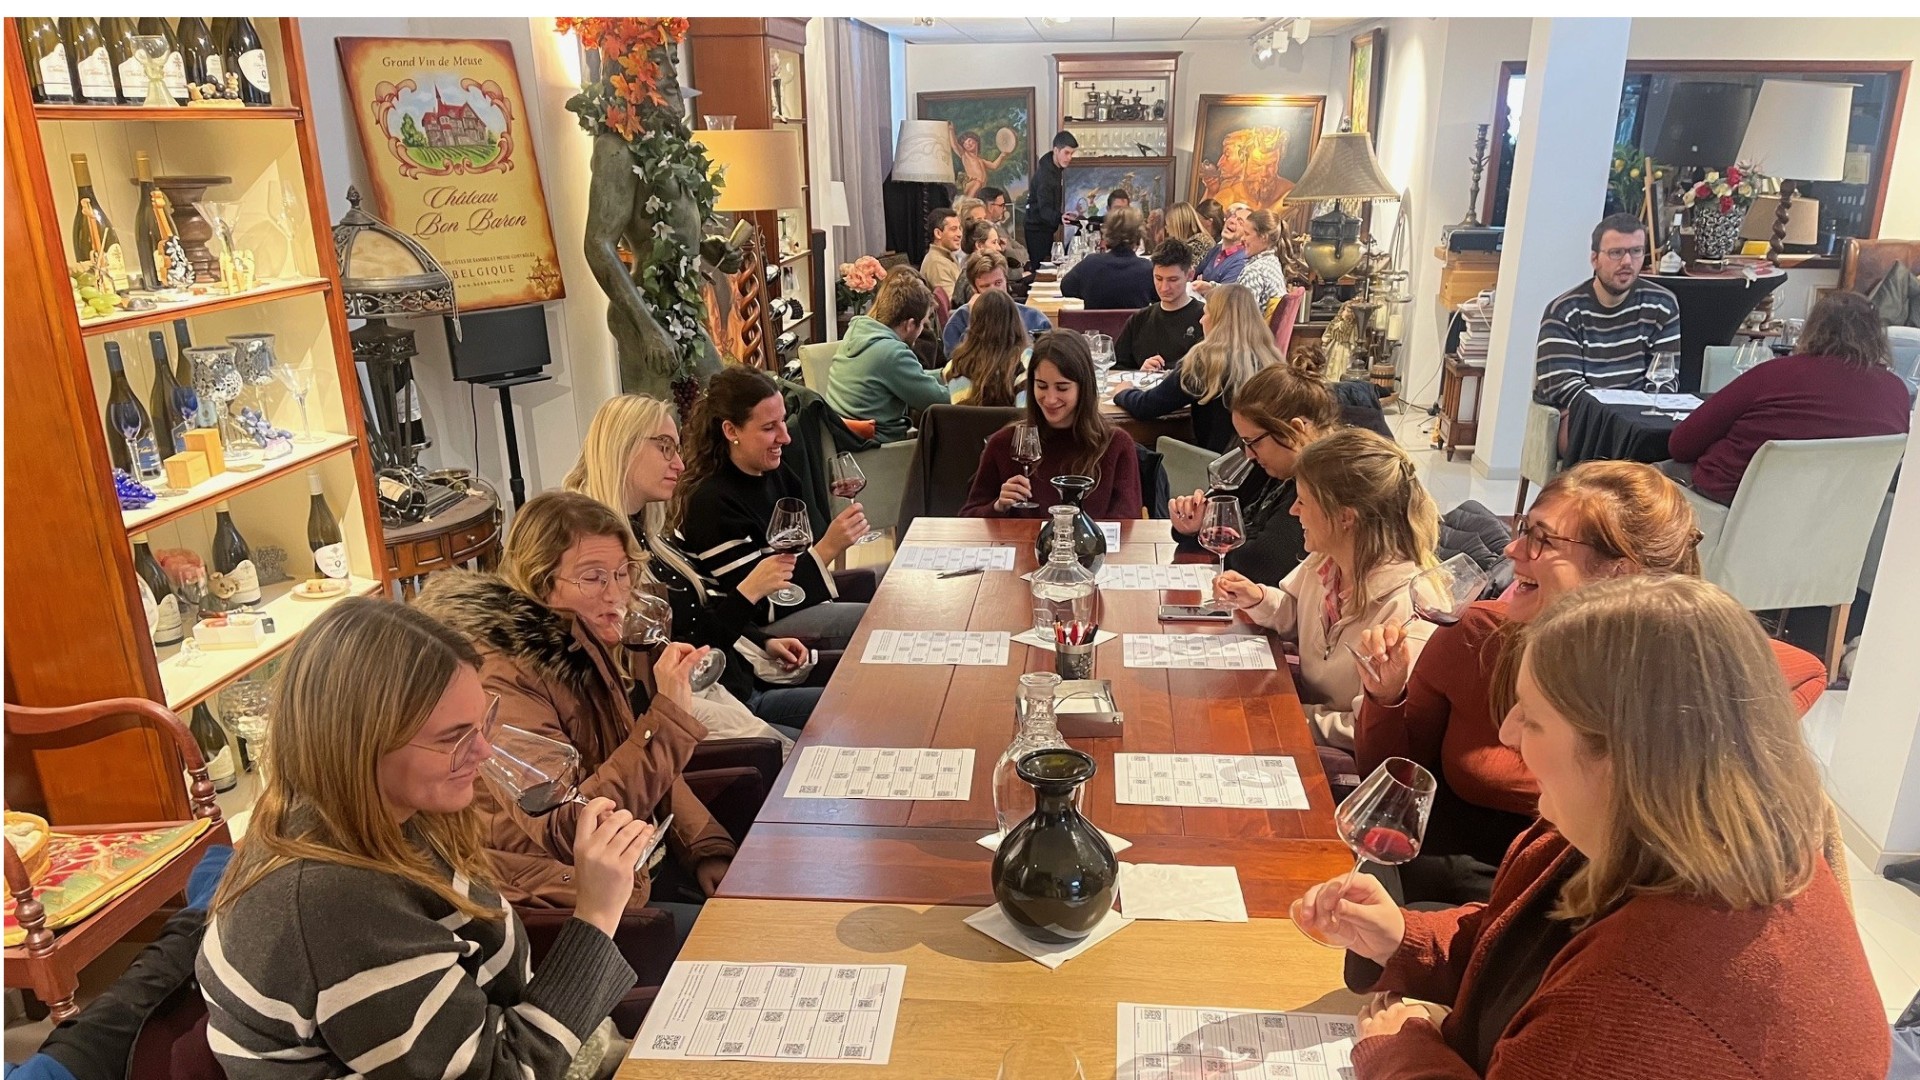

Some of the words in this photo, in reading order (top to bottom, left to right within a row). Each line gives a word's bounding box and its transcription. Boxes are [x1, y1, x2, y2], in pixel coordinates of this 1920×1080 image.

[382, 56, 416, 68] Grand
[418, 56, 436, 67] Vin
[438, 56, 450, 67] de
[453, 55, 483, 66] Meuse
[424, 186, 498, 209] Château
[413, 212, 459, 240] Bon
[466, 208, 527, 235] Baron
[452, 263, 516, 279] BELGIQUE
